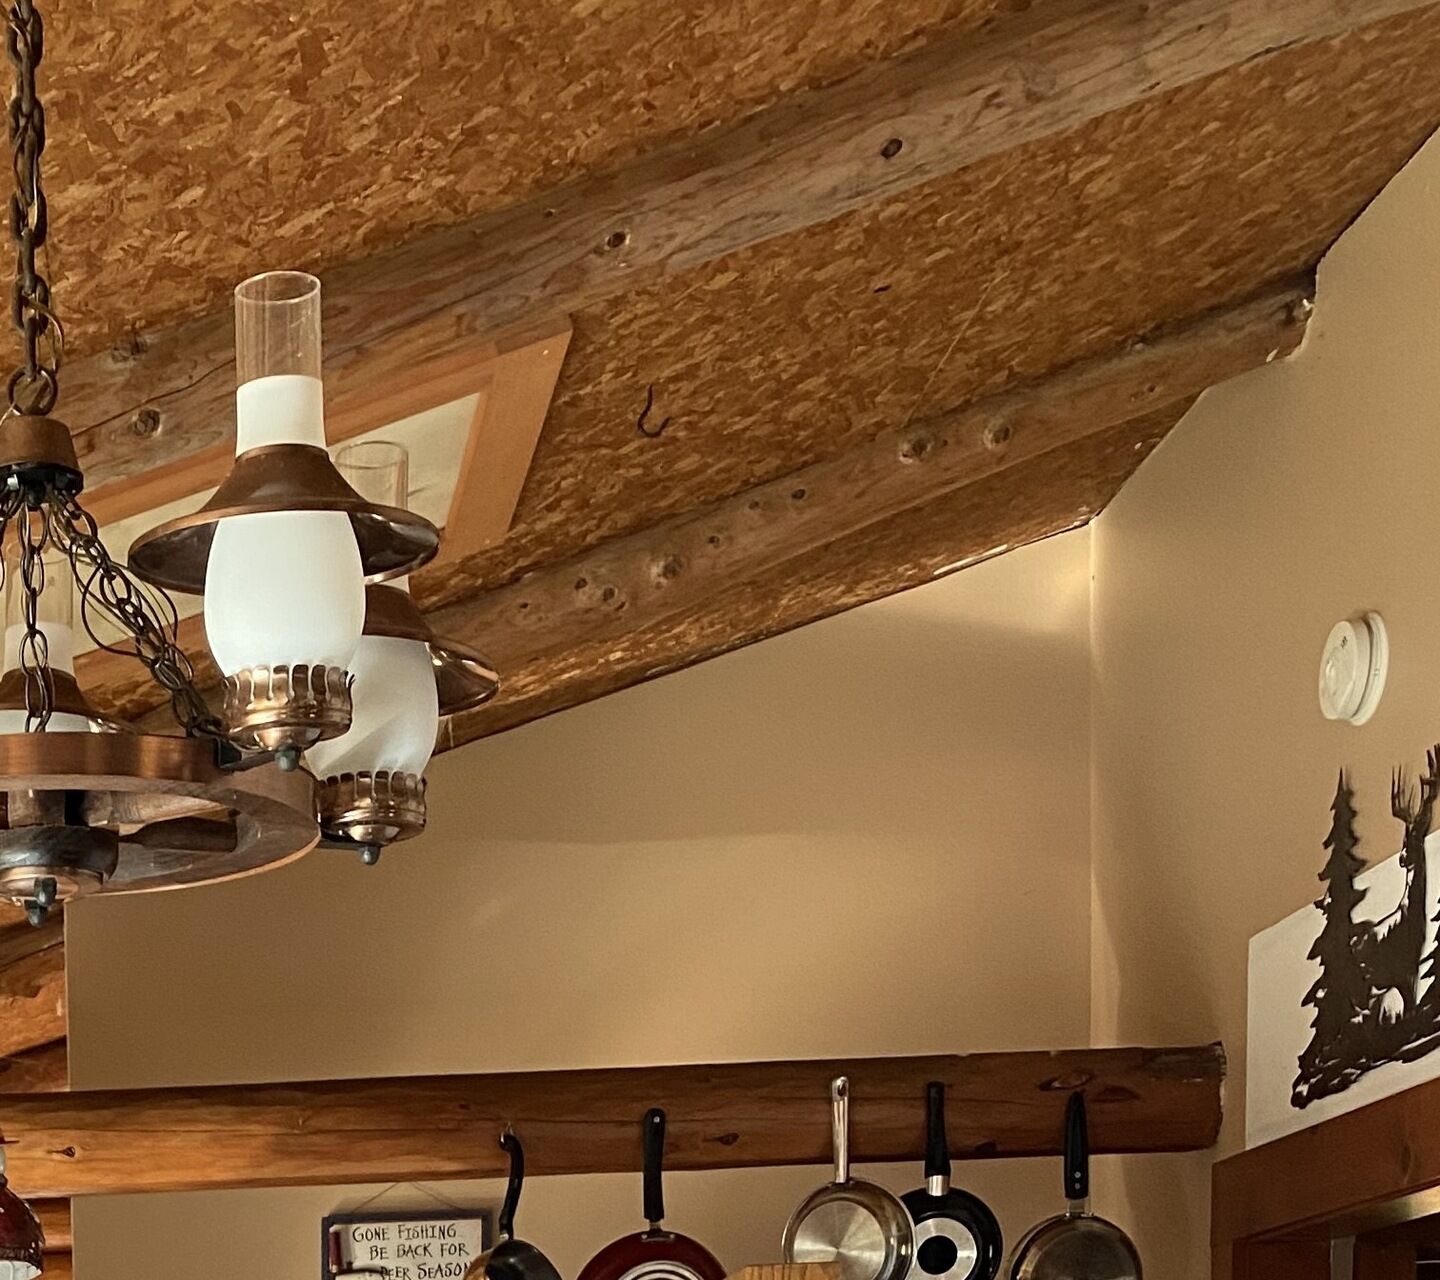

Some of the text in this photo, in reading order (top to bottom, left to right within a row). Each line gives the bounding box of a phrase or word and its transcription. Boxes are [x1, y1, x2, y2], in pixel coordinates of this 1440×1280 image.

[352, 1223, 457, 1243] GONE FISHING
[369, 1242, 470, 1261] BE BACK FOR
